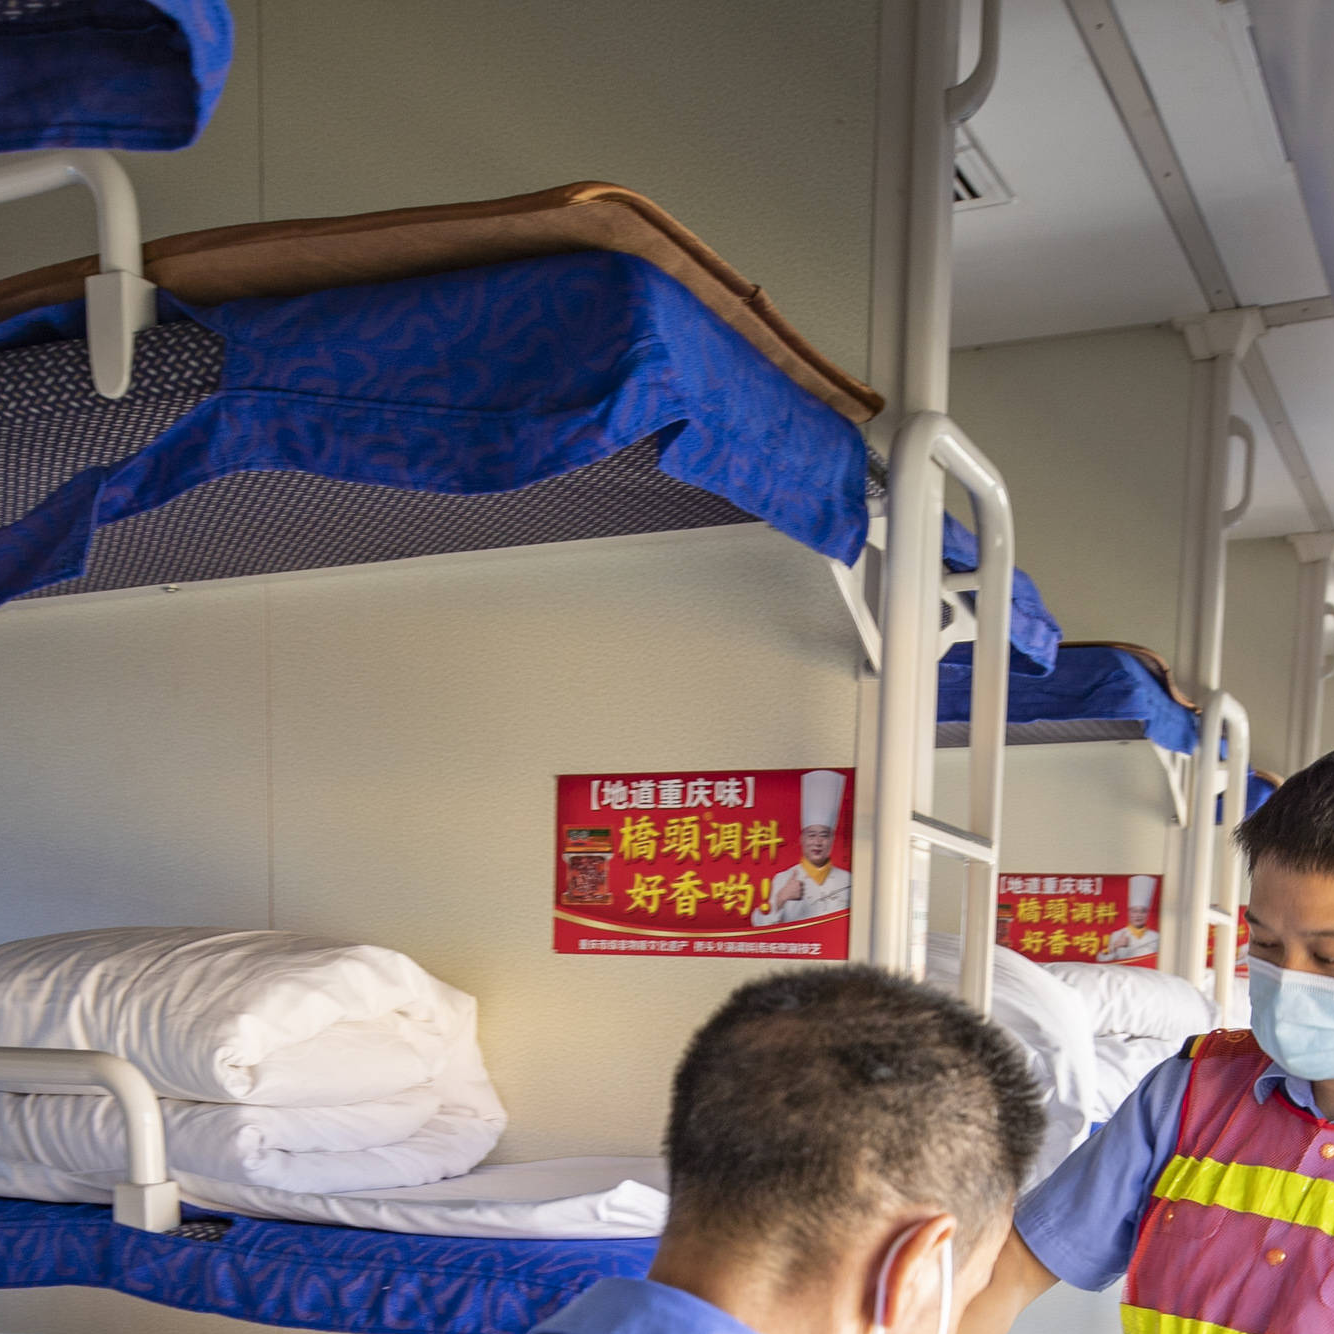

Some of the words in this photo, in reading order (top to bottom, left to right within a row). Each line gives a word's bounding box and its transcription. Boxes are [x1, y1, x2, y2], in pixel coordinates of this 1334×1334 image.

[590, 777, 755, 810] 【地道重庆味】
